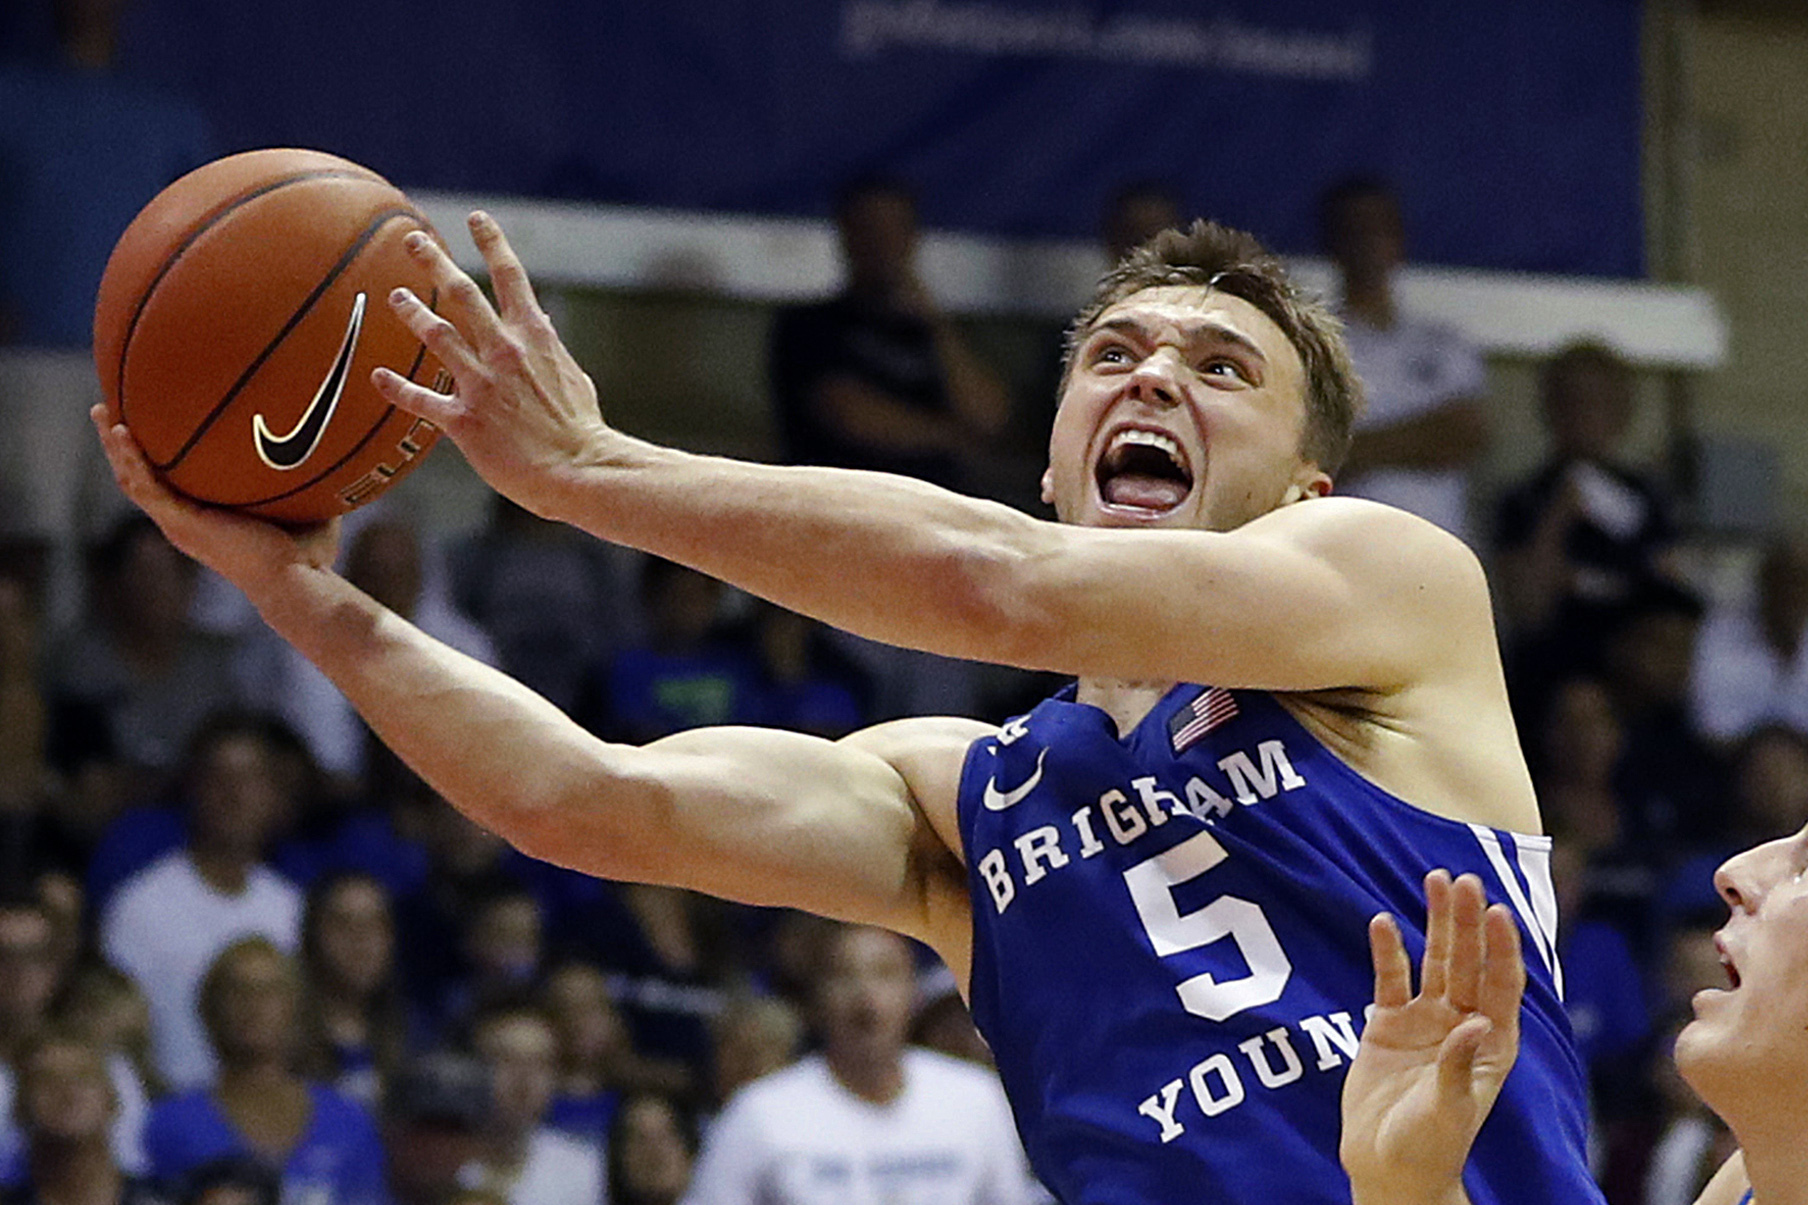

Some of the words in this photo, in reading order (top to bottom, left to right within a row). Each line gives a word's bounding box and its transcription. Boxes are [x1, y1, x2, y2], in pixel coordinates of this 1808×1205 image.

[977, 739, 1307, 914] BRIGHAM
[1122, 829, 1293, 1022] 5
[1137, 1003, 1377, 1143] YOUN
